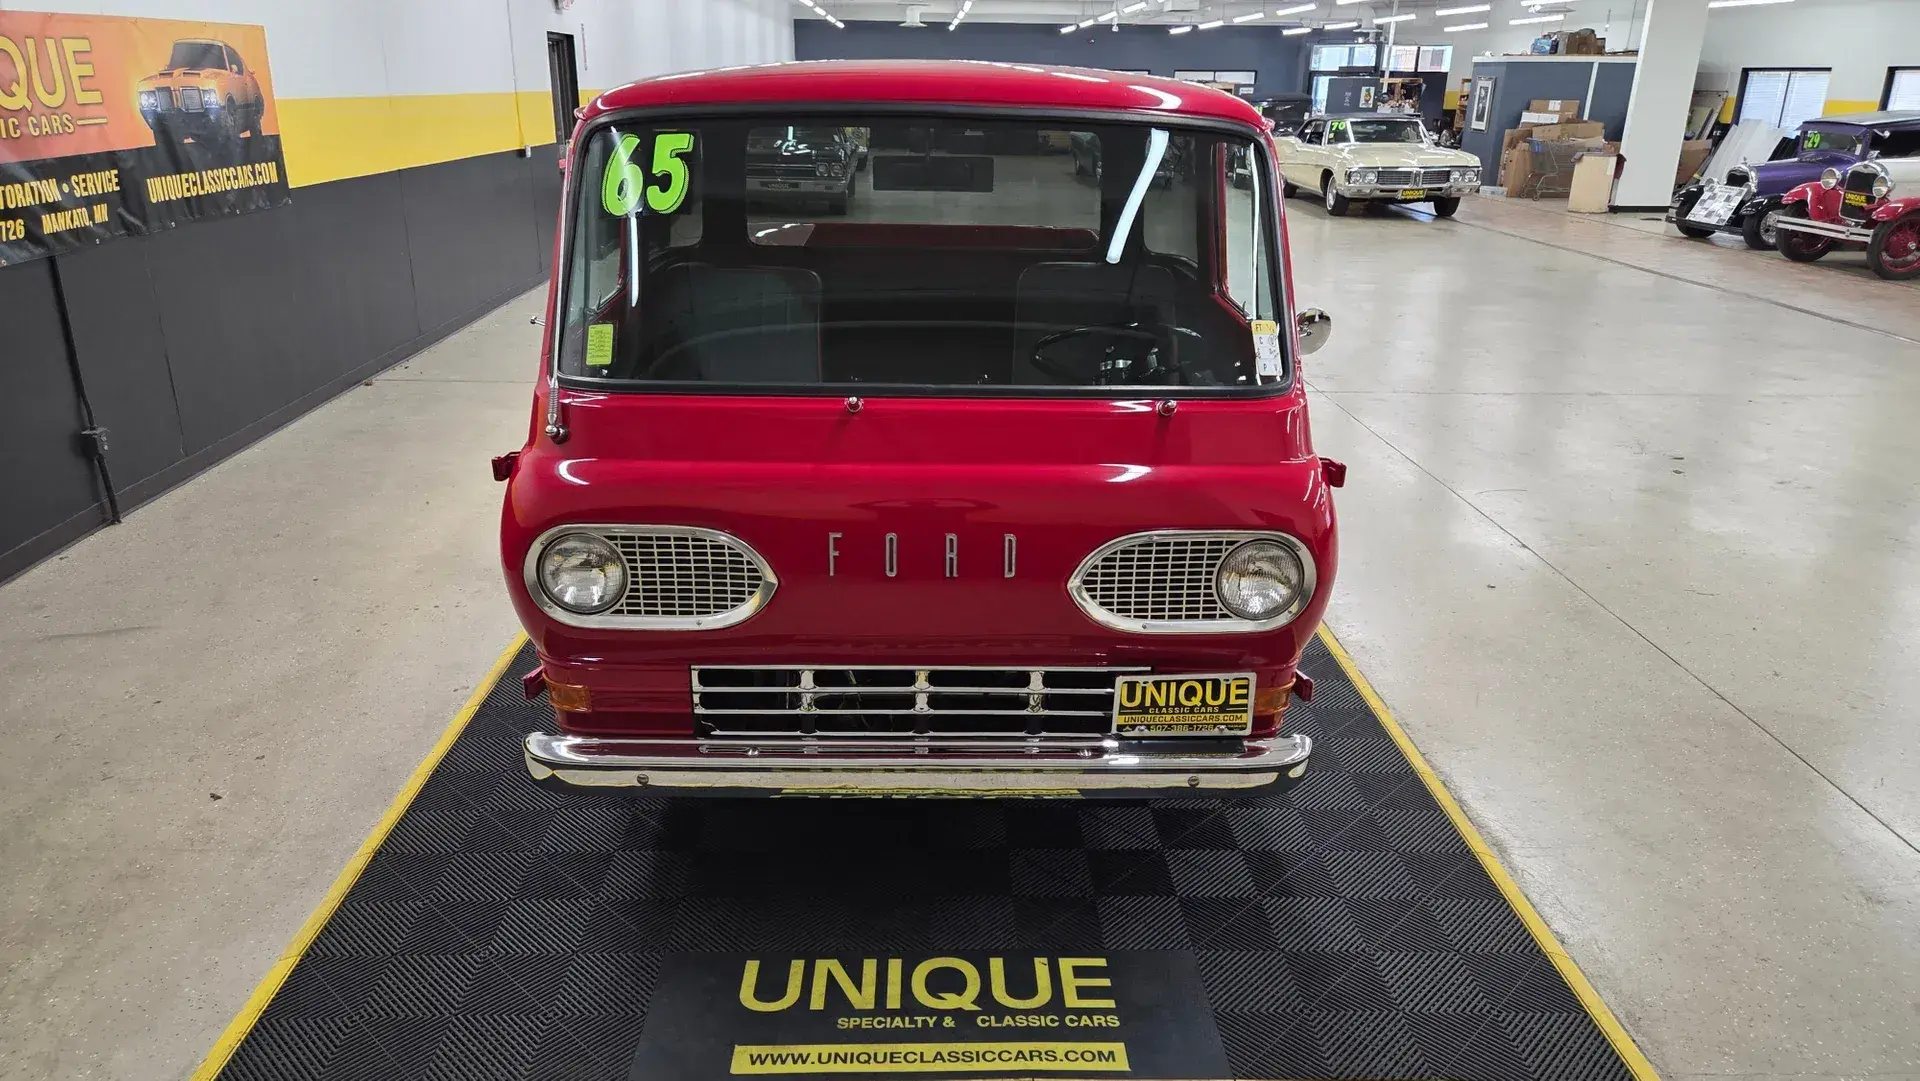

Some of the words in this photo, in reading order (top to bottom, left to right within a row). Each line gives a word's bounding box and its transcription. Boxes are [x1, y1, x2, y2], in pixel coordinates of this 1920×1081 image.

[28, 113, 75, 136] CARS
[1331, 121, 1346, 131] 70
[1807, 131, 1821, 148] 29
[71, 169, 120, 198] SERVICE
[146, 161, 279, 204] UNIQUECLASSICCARS.COM
[602, 133, 695, 217] 65
[41, 207, 94, 235] MANKATO,
[93, 203, 109, 224] MN
[828, 532, 1017, 578] FORD
[1120, 679, 1249, 708] UNIQUE
[1123, 715, 1243, 723] UNIQUECLASSICCARS.COM
[739, 957, 1117, 1013] UNIQUE
[837, 1016, 936, 1029] SPECIALTY
[942, 1016, 956, 1028] &
[976, 1014, 1060, 1028] CLASSIC
[1064, 1014, 1121, 1028] CARS
[749, 1048, 1117, 1066] WWW.UNIQUECLASSICCARS.COM
